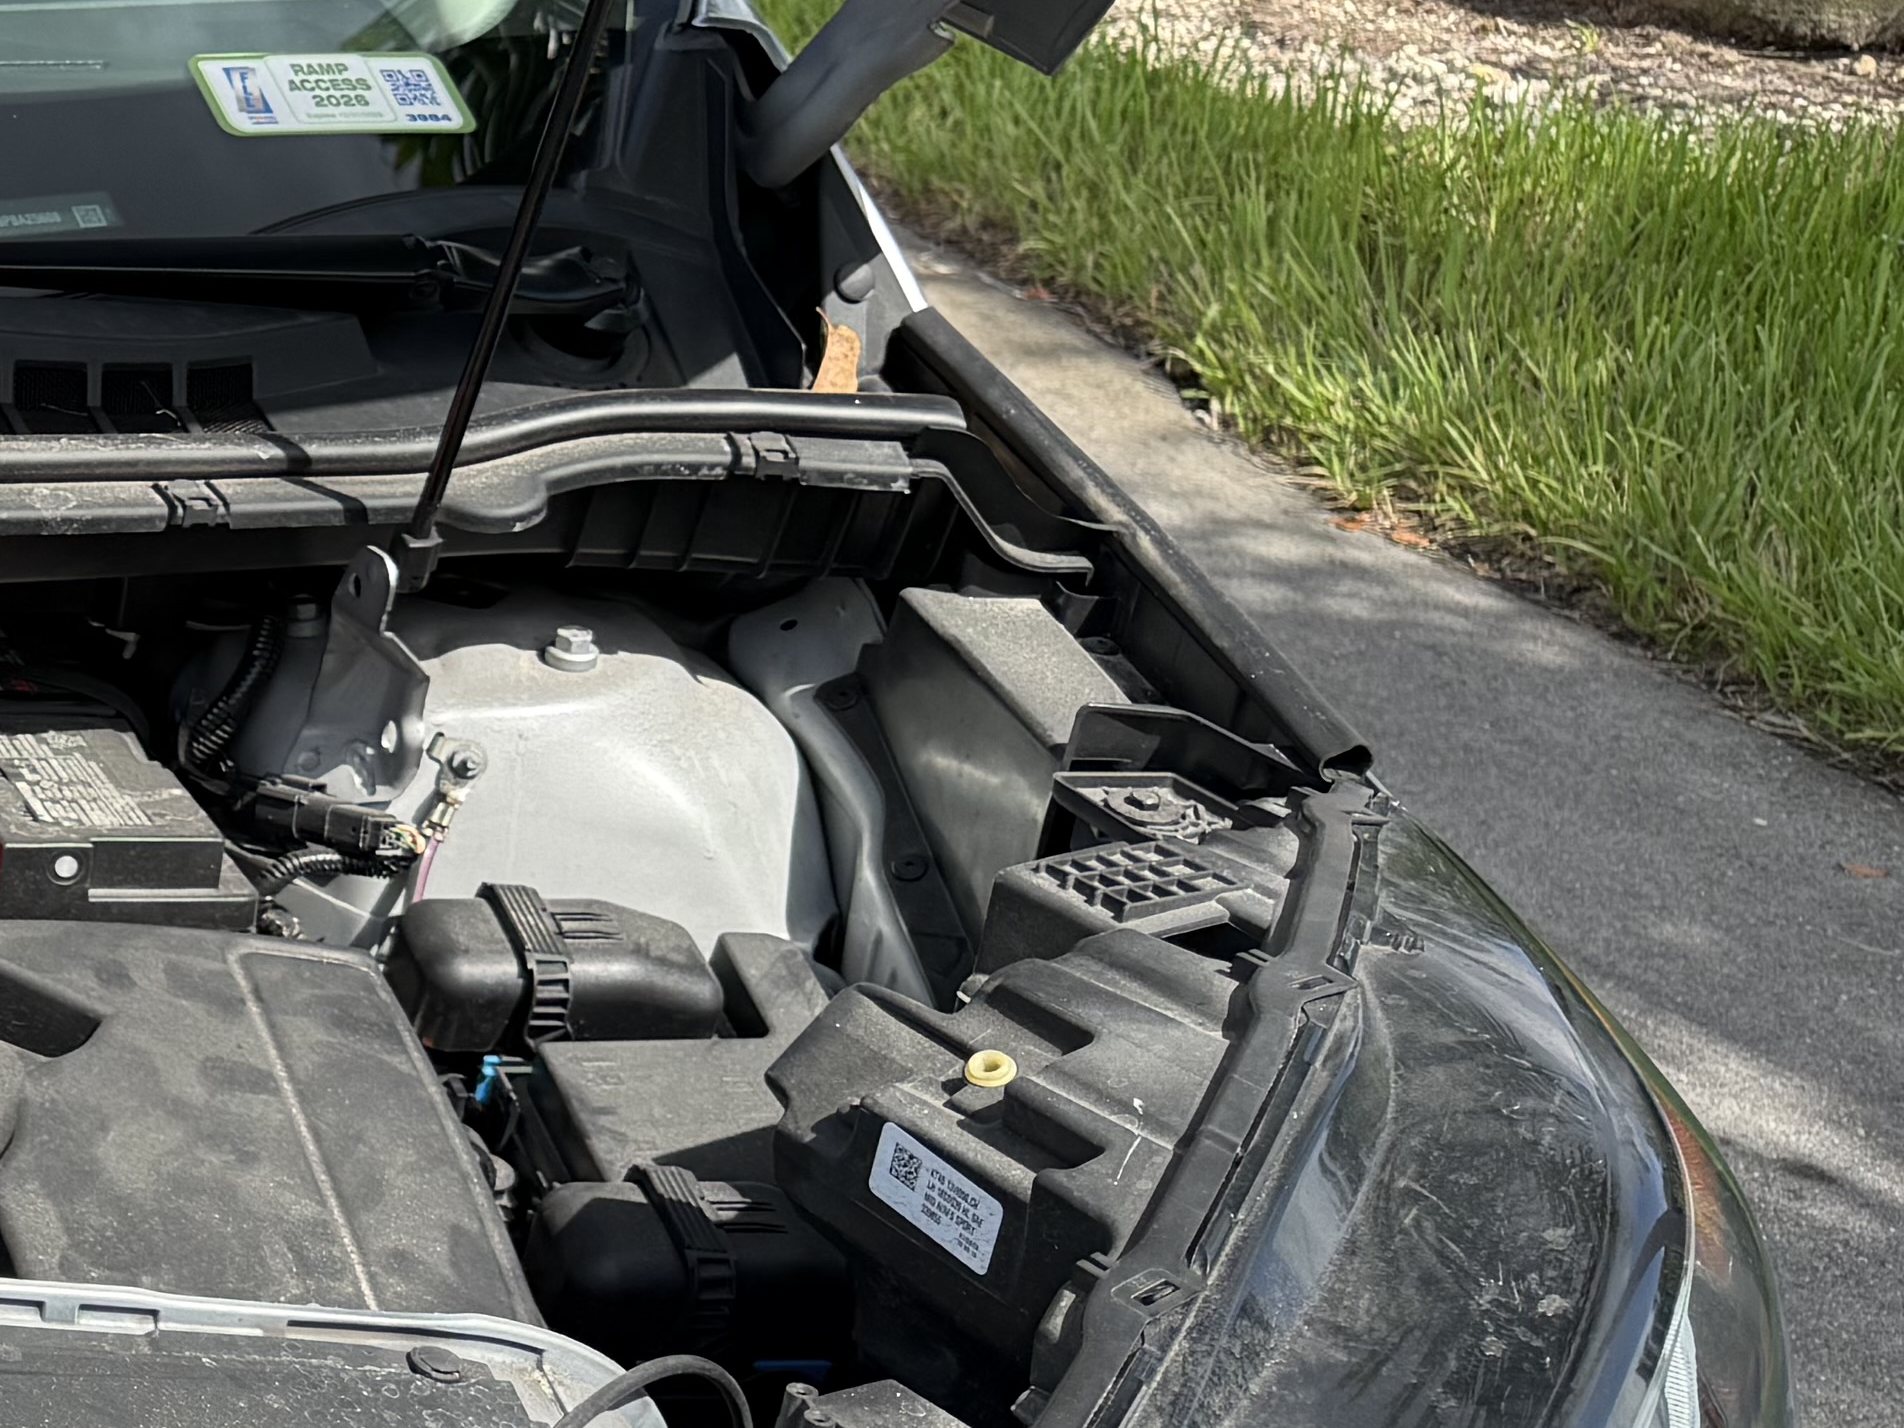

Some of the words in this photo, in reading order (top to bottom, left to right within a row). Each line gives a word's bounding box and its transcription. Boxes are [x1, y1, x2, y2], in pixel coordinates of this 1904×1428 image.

[289, 63, 349, 76] RAMP
[288, 78, 372, 92] ACCESS
[311, 94, 370, 108] 2026
